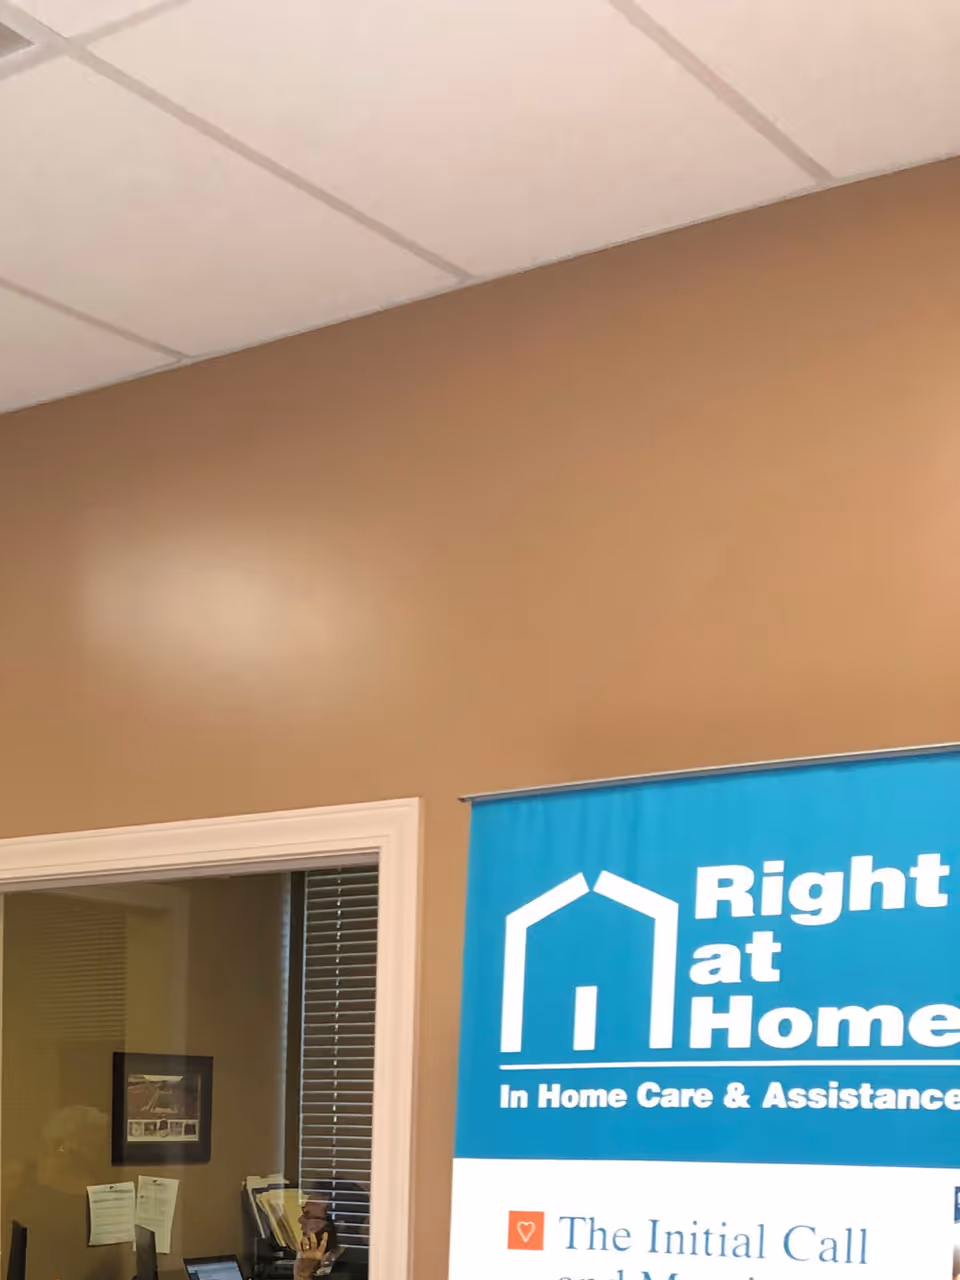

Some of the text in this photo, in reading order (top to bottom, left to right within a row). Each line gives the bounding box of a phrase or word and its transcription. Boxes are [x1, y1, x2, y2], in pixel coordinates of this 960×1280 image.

[694, 853, 950, 926] Right
[689, 930, 782, 985] at
[689, 995, 960, 1049] Home
[499, 1080, 960, 1110] In Home Care & Assistance
[559, 1215, 869, 1264] The Initial Call
